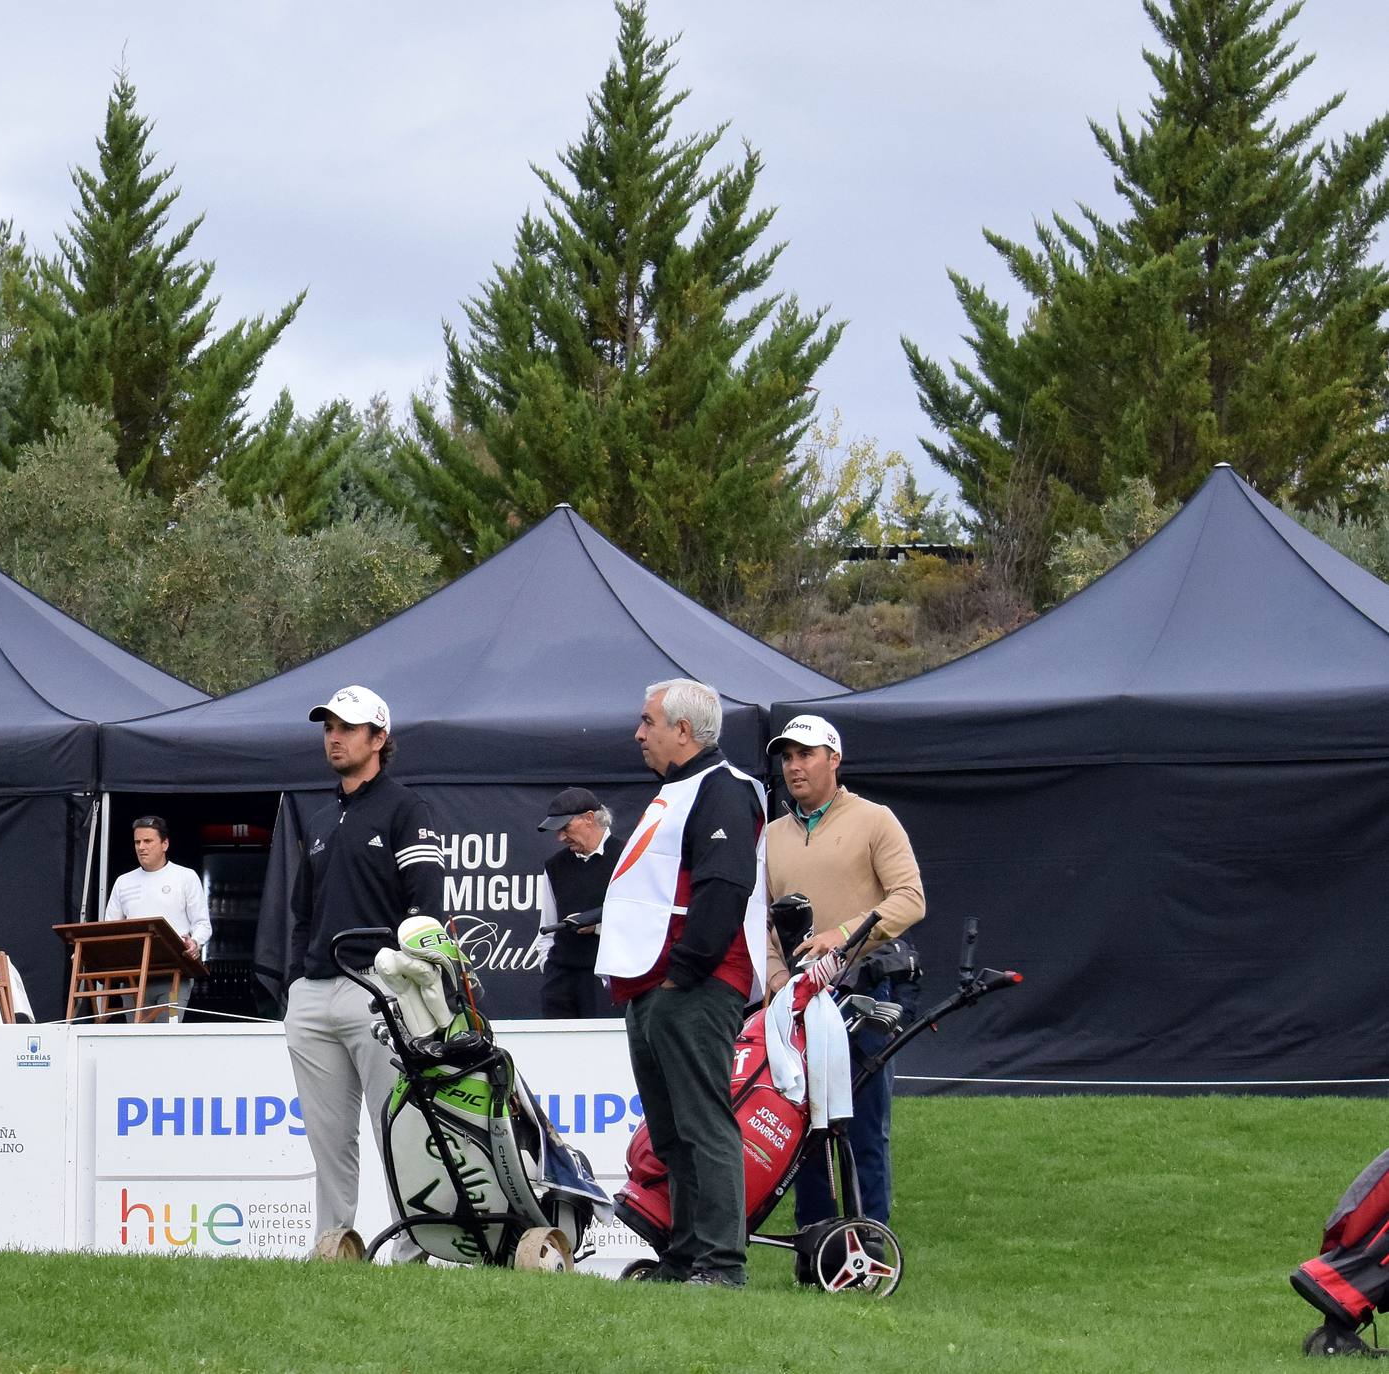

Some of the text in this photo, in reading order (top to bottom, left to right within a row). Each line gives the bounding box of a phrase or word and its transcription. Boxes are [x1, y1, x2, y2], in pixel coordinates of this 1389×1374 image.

[440, 832, 508, 870] HOU
[443, 874, 545, 912] MIGU
[445, 914, 540, 971] Club
[533, 1093, 644, 1134] LIPS
[755, 1106, 792, 1140] JOSE LUIS
[747, 1115, 787, 1153] ADARRAGA
[121, 1188, 244, 1246] hue
[248, 1201, 312, 1216] personal
[248, 1217, 312, 1229] wireless
[248, 1232, 307, 1247] lighting
[593, 1232, 648, 1248] ighting
